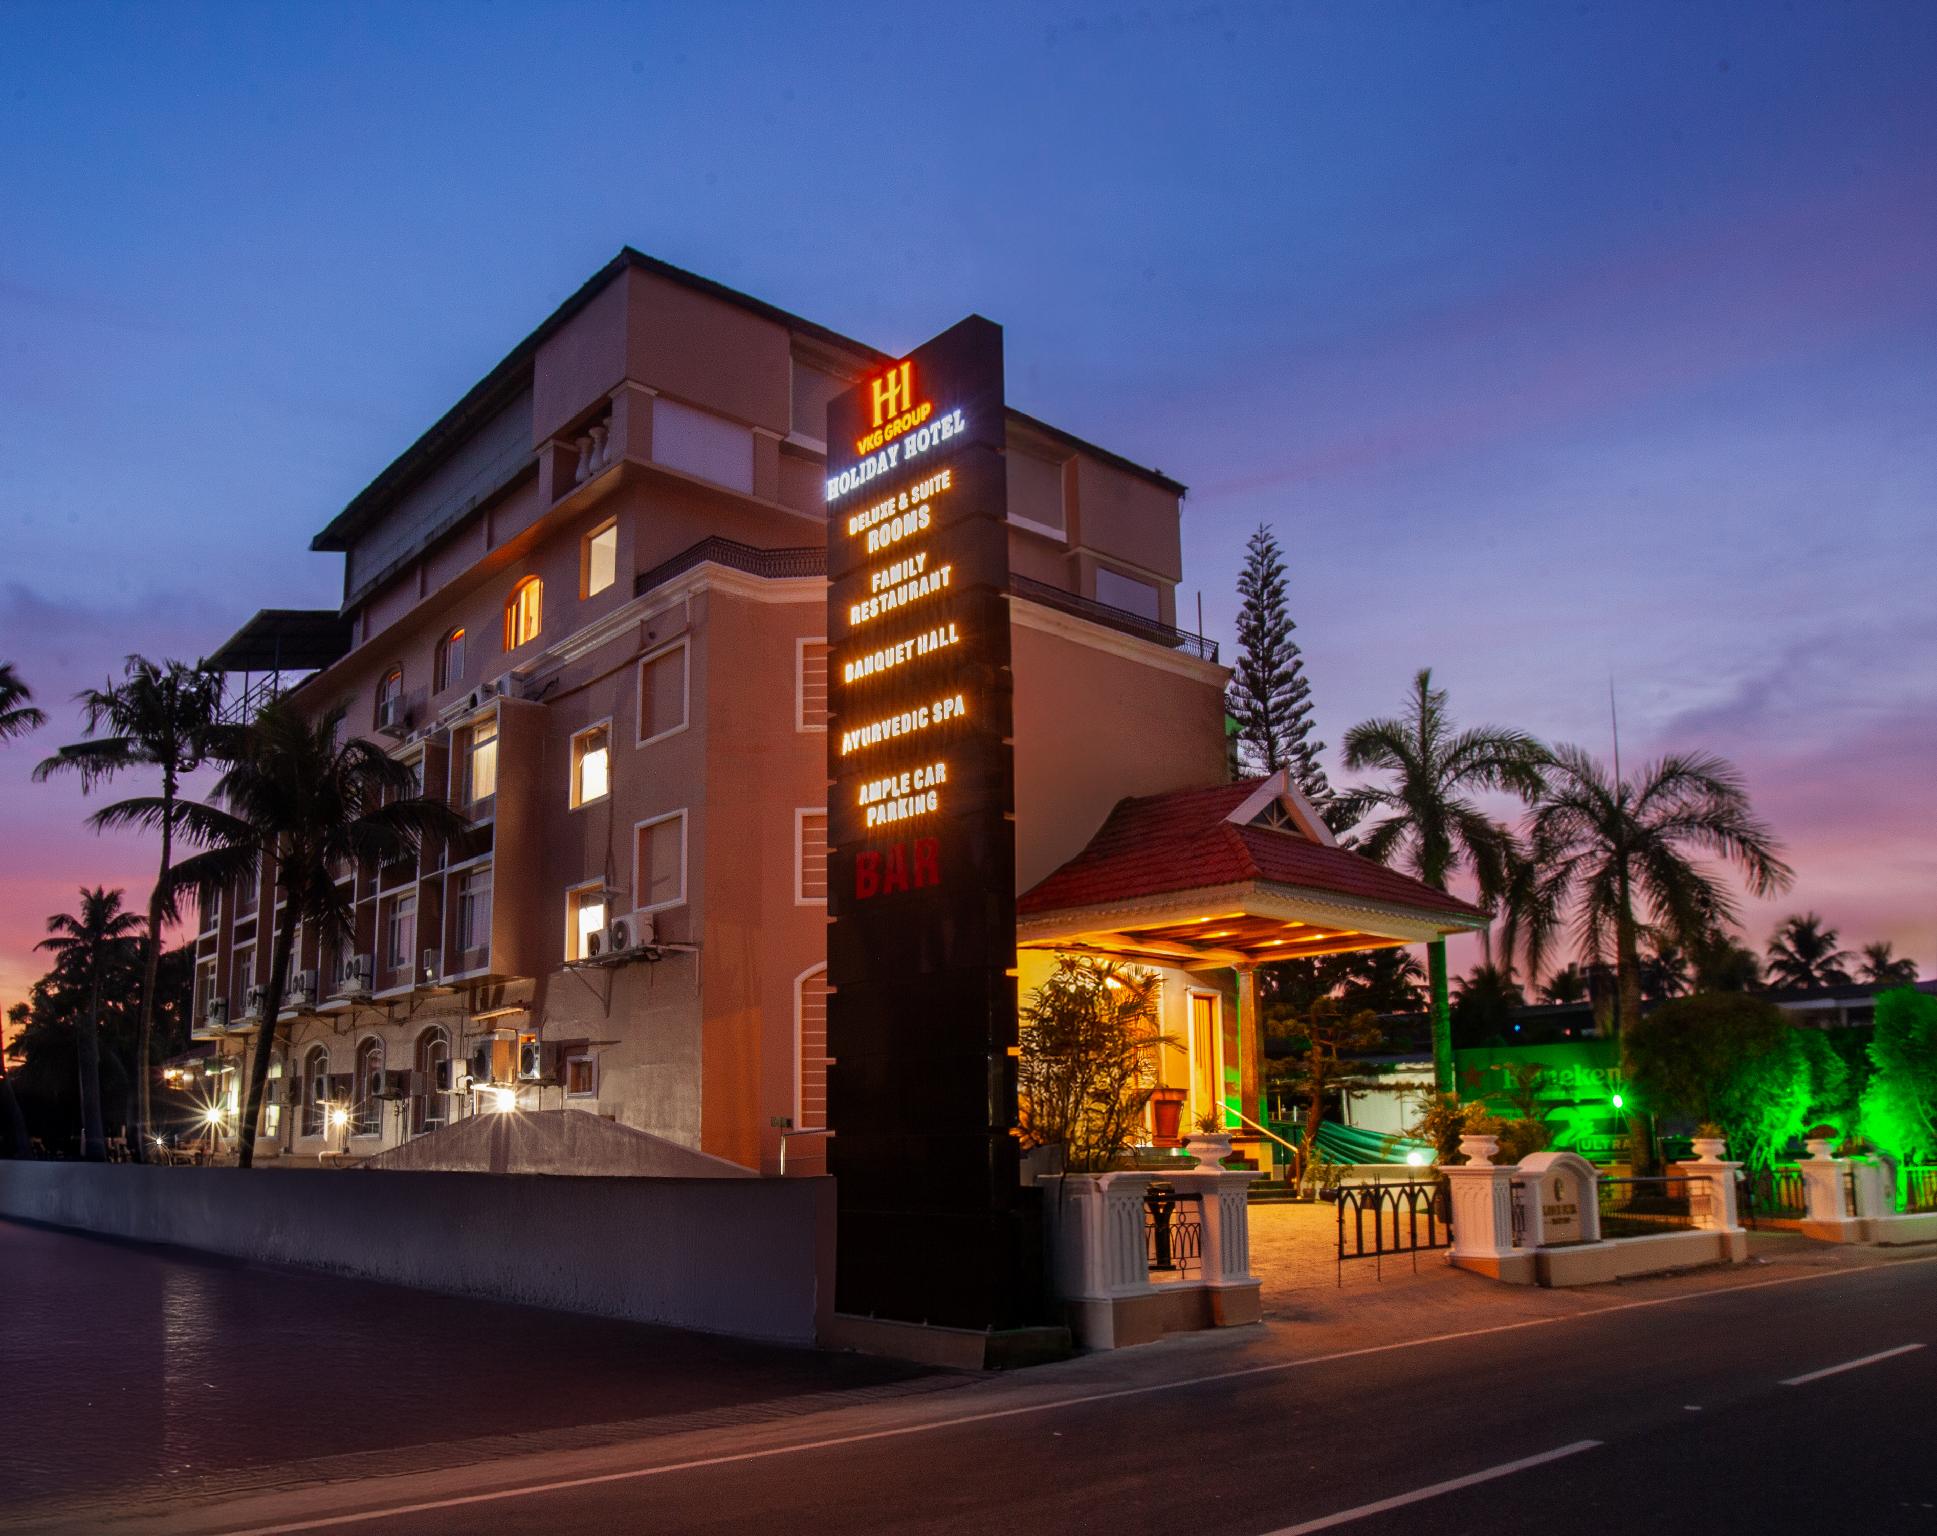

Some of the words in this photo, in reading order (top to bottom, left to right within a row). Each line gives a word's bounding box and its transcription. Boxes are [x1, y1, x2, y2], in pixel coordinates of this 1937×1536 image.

[827, 443, 900, 501] HOLIDAY
[904, 409, 966, 460] HOTEL
[856, 429, 884, 455] VKG
[884, 402, 931, 442] GROUP
[849, 497, 896, 536] DELUXE
[898, 492, 909, 511] &
[911, 470, 951, 503] SUITE
[867, 504, 931, 554] ROOMS
[850, 565, 951, 625] RESTAURANT
[871, 552, 926, 594] FAMILY
[844, 638, 916, 684] BANQUET
[917, 623, 960, 656] HALL
[842, 706, 929, 756] AYURVEDIC
[932, 694, 965, 724] SPA
[858, 772, 910, 806] AMPLE
[913, 762, 947, 790] CAR
[866, 790, 938, 828] PARKING
[855, 836, 941, 901] BAR
